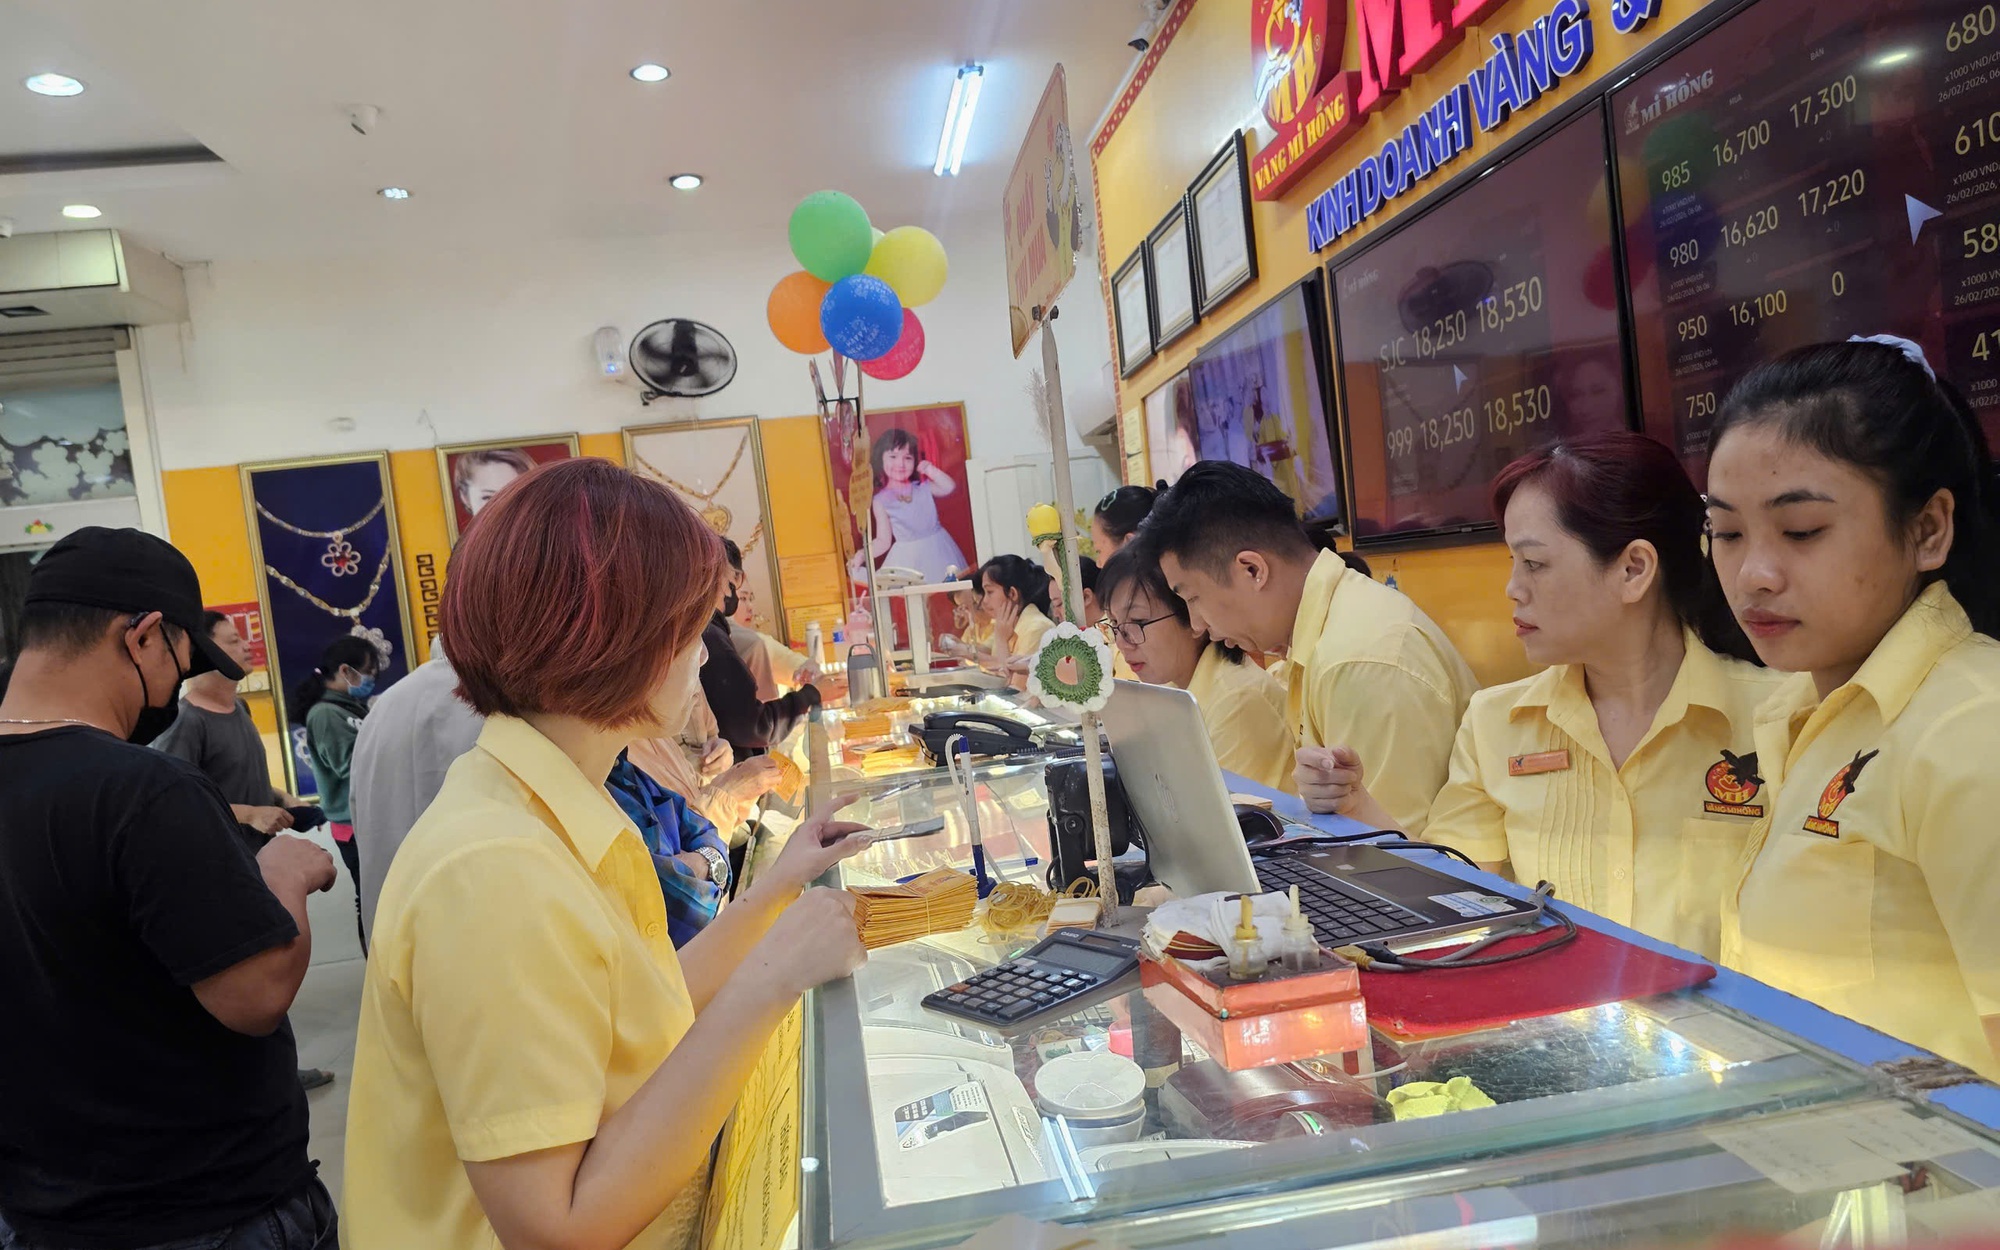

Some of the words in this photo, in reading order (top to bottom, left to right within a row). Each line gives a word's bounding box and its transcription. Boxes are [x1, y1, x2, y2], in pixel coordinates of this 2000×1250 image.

[1945, 4, 1996, 52] 680
[1665, 67, 1715, 113] HỒNG
[1254, 158, 1287, 192] VÀNG
[1306, 94, 1346, 149] HỒNG
[1305, 168, 1360, 255] KINH
[1359, 82, 1471, 217] DOANH
[1467, 0, 1590, 132] VÀNG
[1661, 160, 1691, 192] 985
[1712, 119, 1771, 168] 16,700
[1789, 75, 1857, 129] 17,300
[1669, 238, 1699, 268] 980
[1720, 205, 1779, 248] 16,620
[1798, 169, 1866, 217] 17,220
[1963, 223, 2000, 259] 58
[1380, 336, 1406, 374] SJC
[1412, 309, 1467, 360] 18,250
[1475, 275, 1542, 333] 18,530
[1677, 315, 1708, 343] 950
[1729, 289, 1788, 327] 16,100
[1831, 270, 1845, 297] 0
[1387, 426, 1413, 460] 999
[1420, 407, 1475, 453] 18,250
[1484, 384, 1551, 436] 18,530
[1685, 391, 1716, 419] 750
[1060, 931, 1080, 939] CASIO
